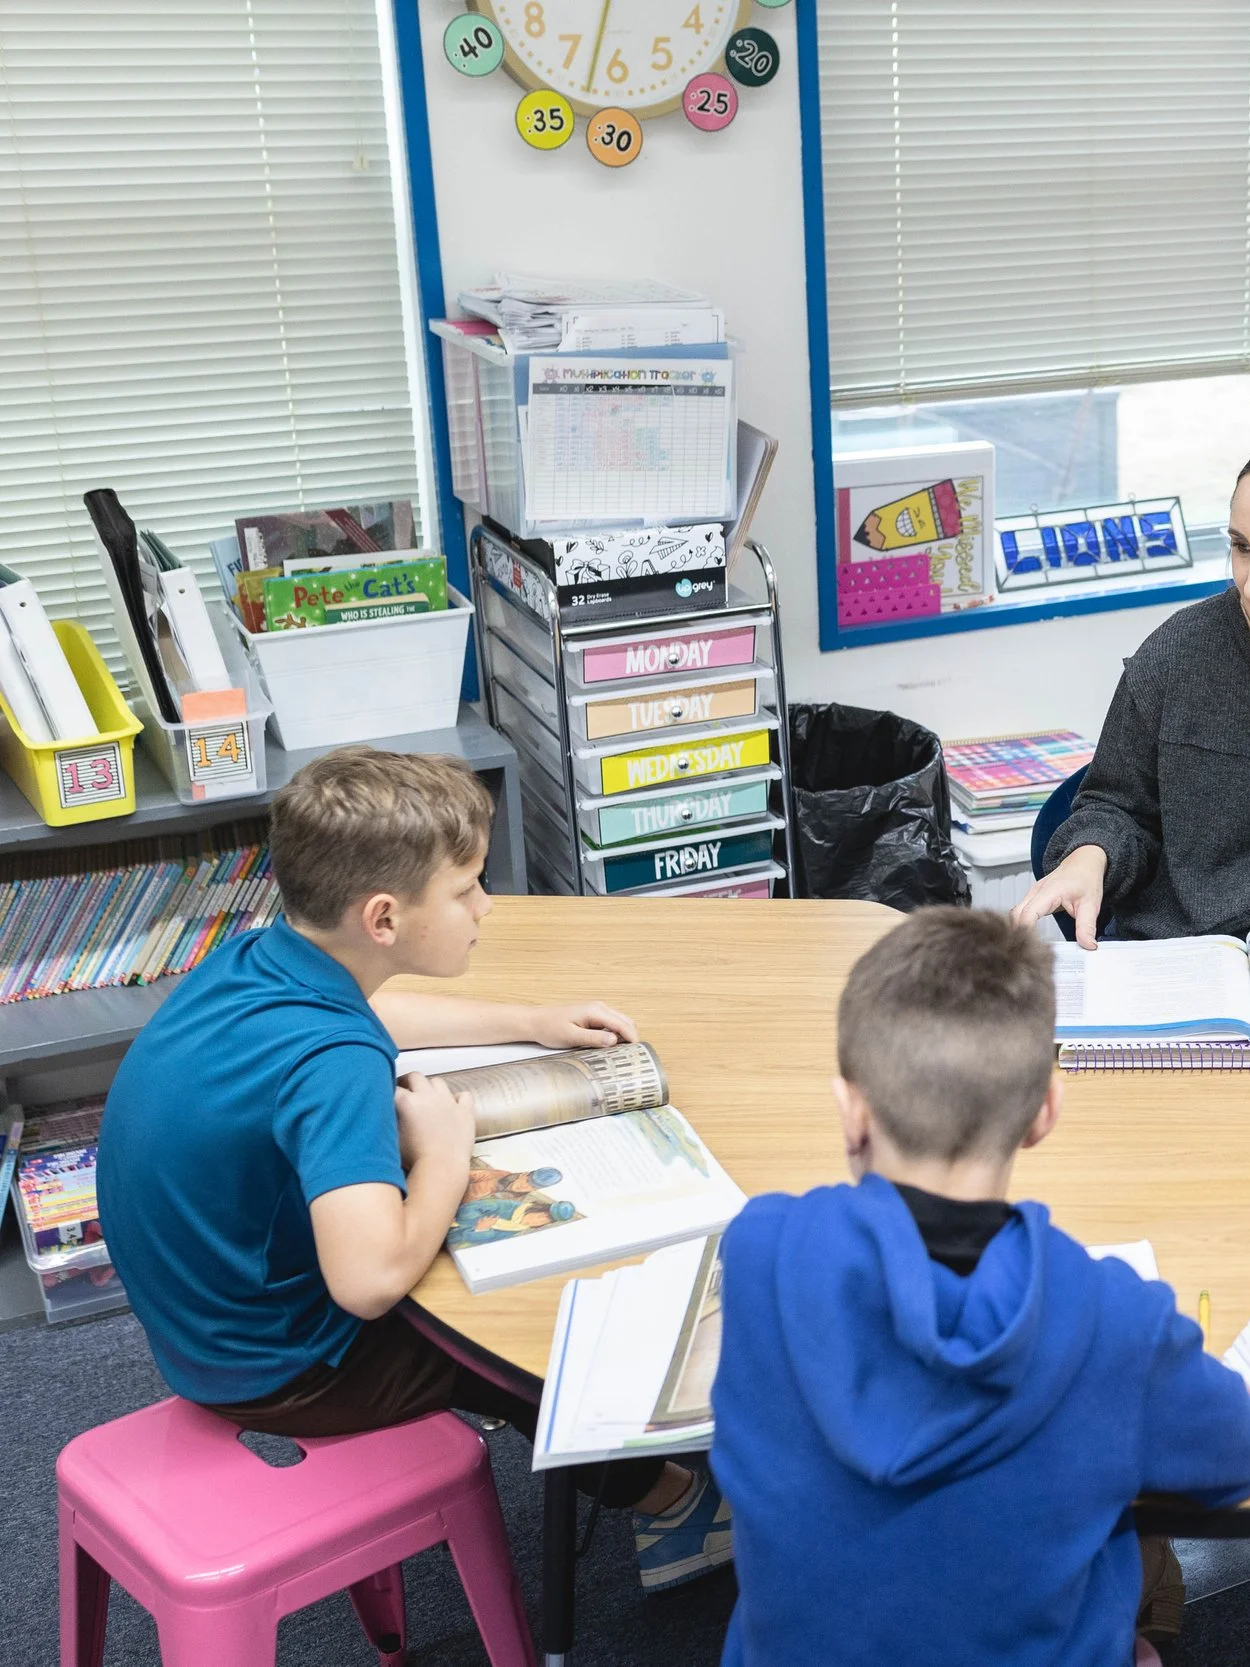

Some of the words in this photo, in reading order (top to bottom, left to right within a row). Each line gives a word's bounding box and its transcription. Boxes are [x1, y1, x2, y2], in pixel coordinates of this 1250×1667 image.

[524, 1, 545, 38] 8
[683, 5, 704, 35] 4
[558, 34, 582, 71] 7
[606, 48, 629, 84] 6
[650, 37, 673, 72] 5
[1001, 511, 1179, 575] LIONS
[293, 586, 345, 608] Pete
[343, 579, 361, 593] the
[362, 573, 417, 599] Cat's
[571, 595, 586, 607] 32
[341, 608, 359, 621] WHO
[360, 607, 368, 619] IS
[369, 604, 405, 618] STEALING
[625, 639, 713, 674] MONDAY
[627, 692, 715, 730] TUESDAY
[194, 732, 241, 768] 14
[627, 741, 745, 787] WEDNESDAY
[64, 757, 113, 794] 13
[654, 842, 722, 881] FRIDAY
